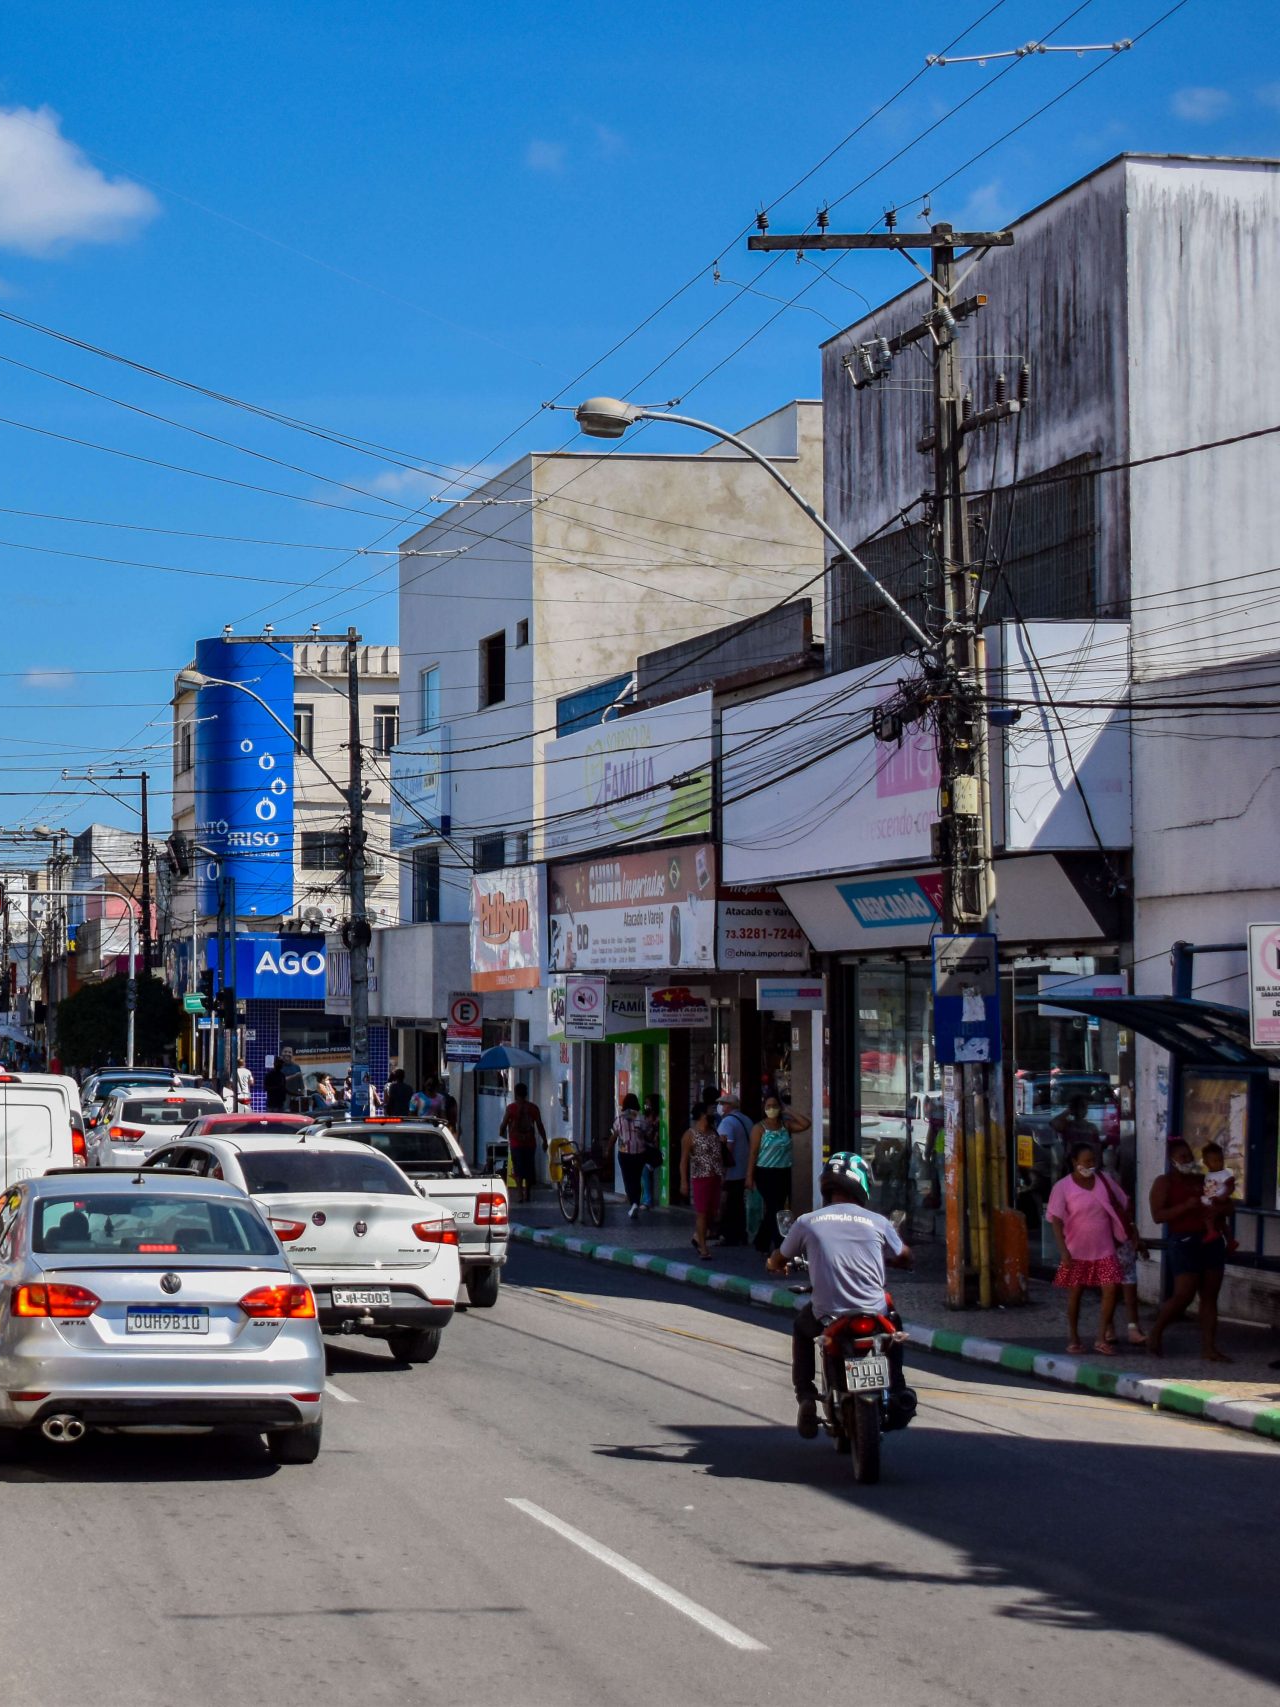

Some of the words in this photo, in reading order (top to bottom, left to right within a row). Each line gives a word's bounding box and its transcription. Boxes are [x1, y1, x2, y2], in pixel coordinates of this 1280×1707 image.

[725, 907, 763, 916] Atacado
[725, 927, 803, 940] 73.3281-7244
[735, 948, 803, 958] china.importados
[460, 1003, 470, 1020] E
[810, 1213, 852, 1225] MANUTENÇÃO
[853, 1375, 885, 1389] 1289
